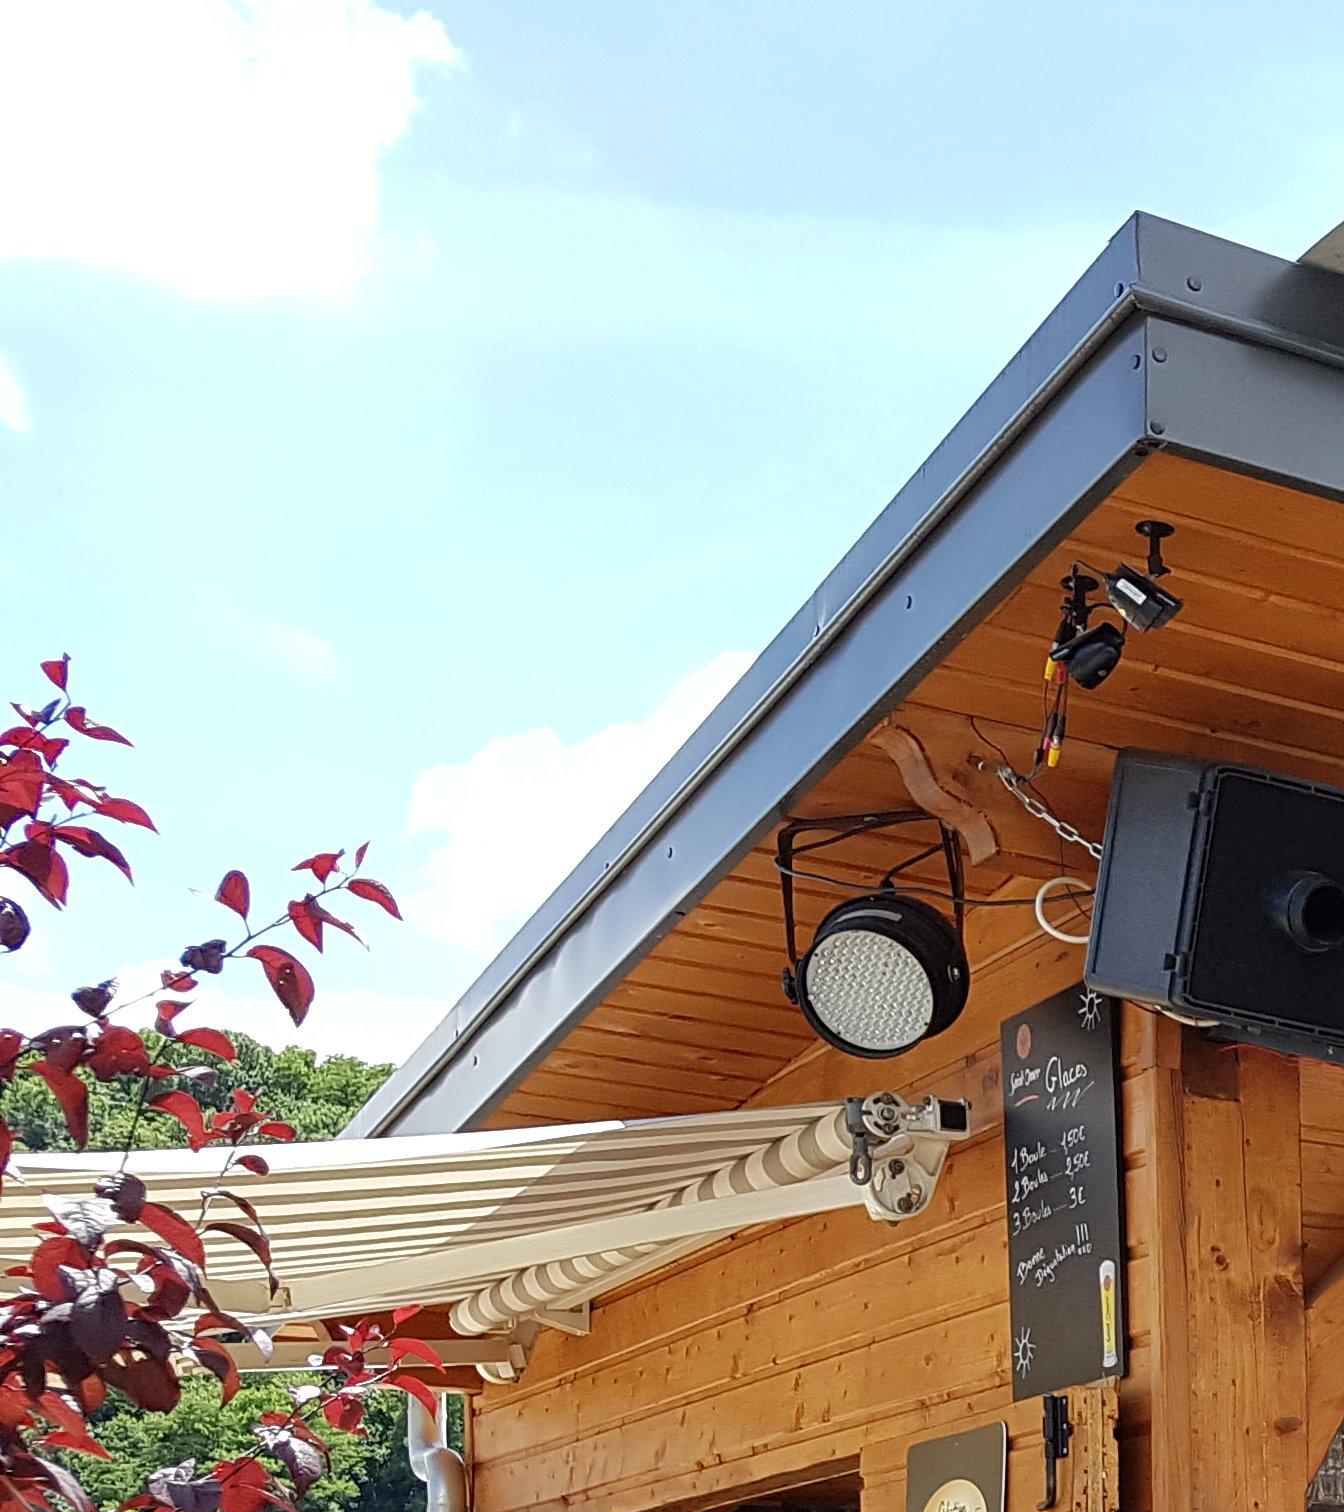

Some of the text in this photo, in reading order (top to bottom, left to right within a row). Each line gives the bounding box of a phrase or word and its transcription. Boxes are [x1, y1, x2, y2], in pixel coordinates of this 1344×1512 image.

[1046, 1056, 1088, 1093] Glaces
[1011, 1148, 1019, 1174] 1
[1020, 1141, 1047, 1172] Boule
[1012, 1180, 1020, 1203] 2
[1021, 1168, 1049, 1200] Boules
[1013, 1212, 1021, 1236] 3
[1022, 1200, 1052, 1230] Boules
